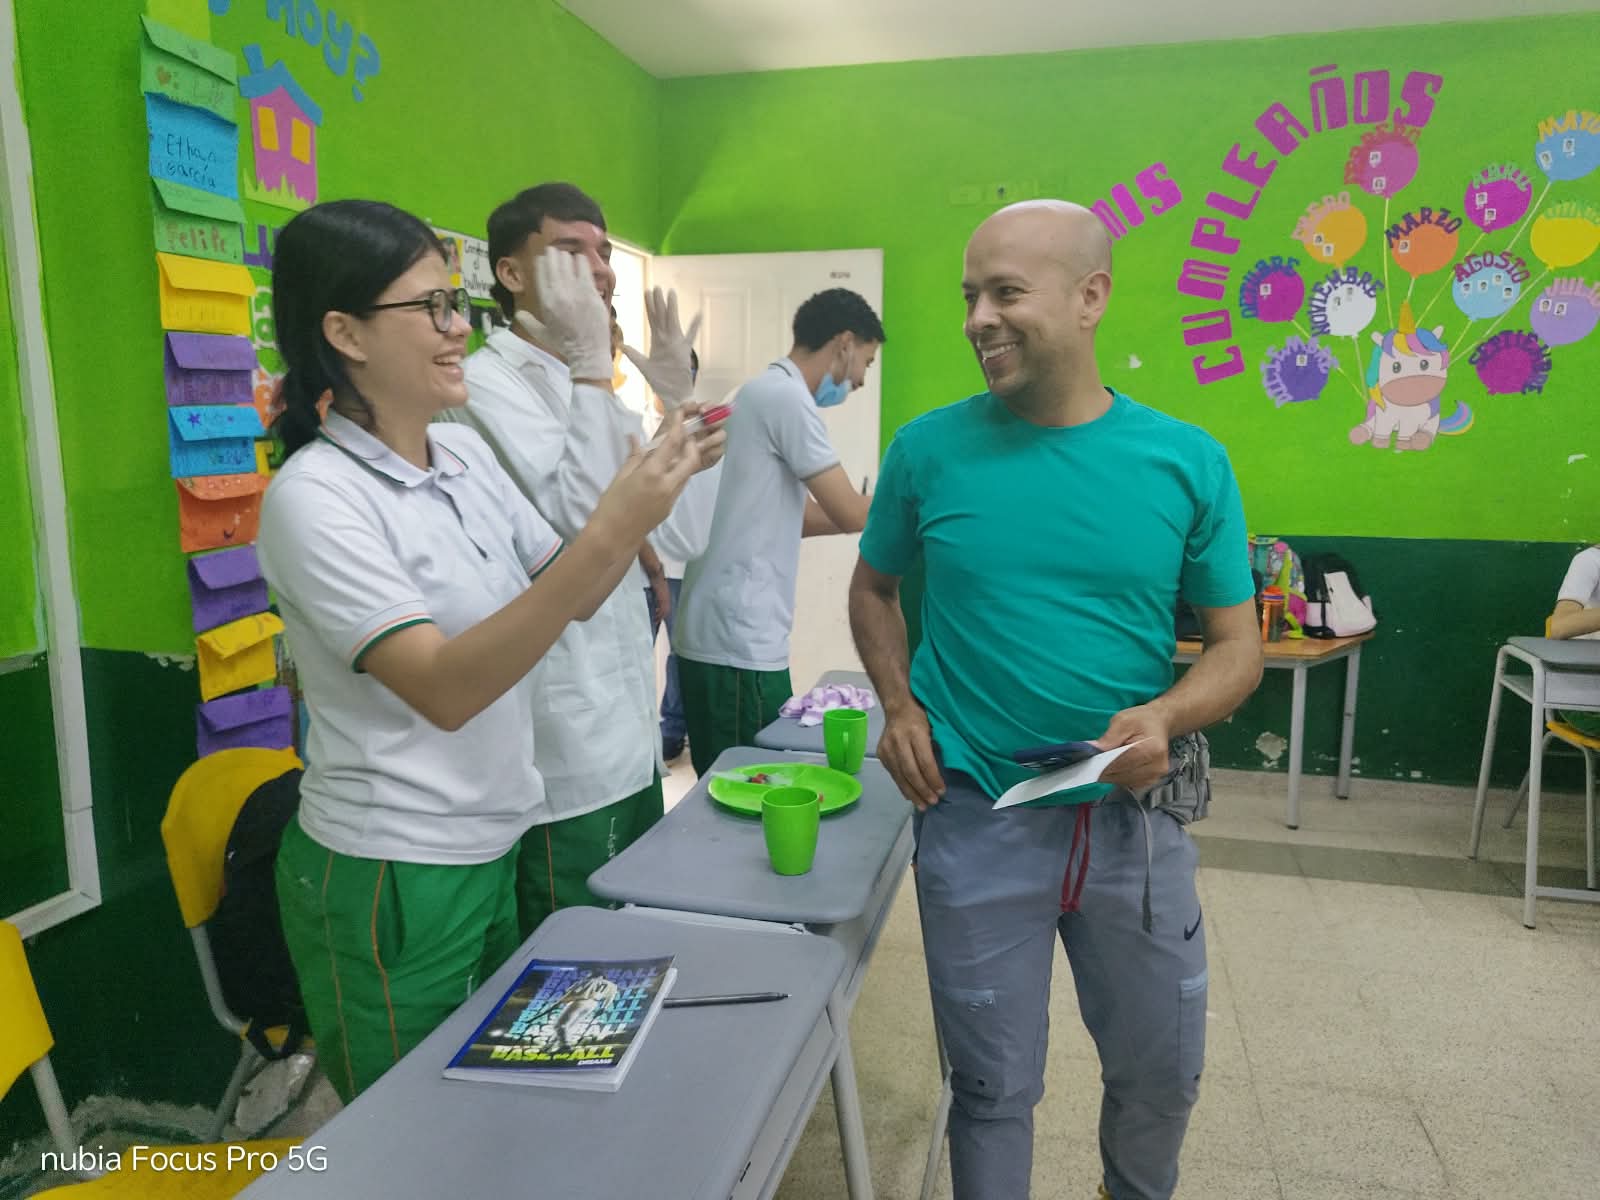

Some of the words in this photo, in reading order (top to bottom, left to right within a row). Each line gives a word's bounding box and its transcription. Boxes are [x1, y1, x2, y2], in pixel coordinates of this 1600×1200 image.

[1177, 63, 1444, 385] CUMPLEAÑOS
[1385, 206, 1463, 249] MARZO
[1453, 249, 1531, 284] AGOSTO
[1307, 266, 1385, 338] NOVIEMBRE
